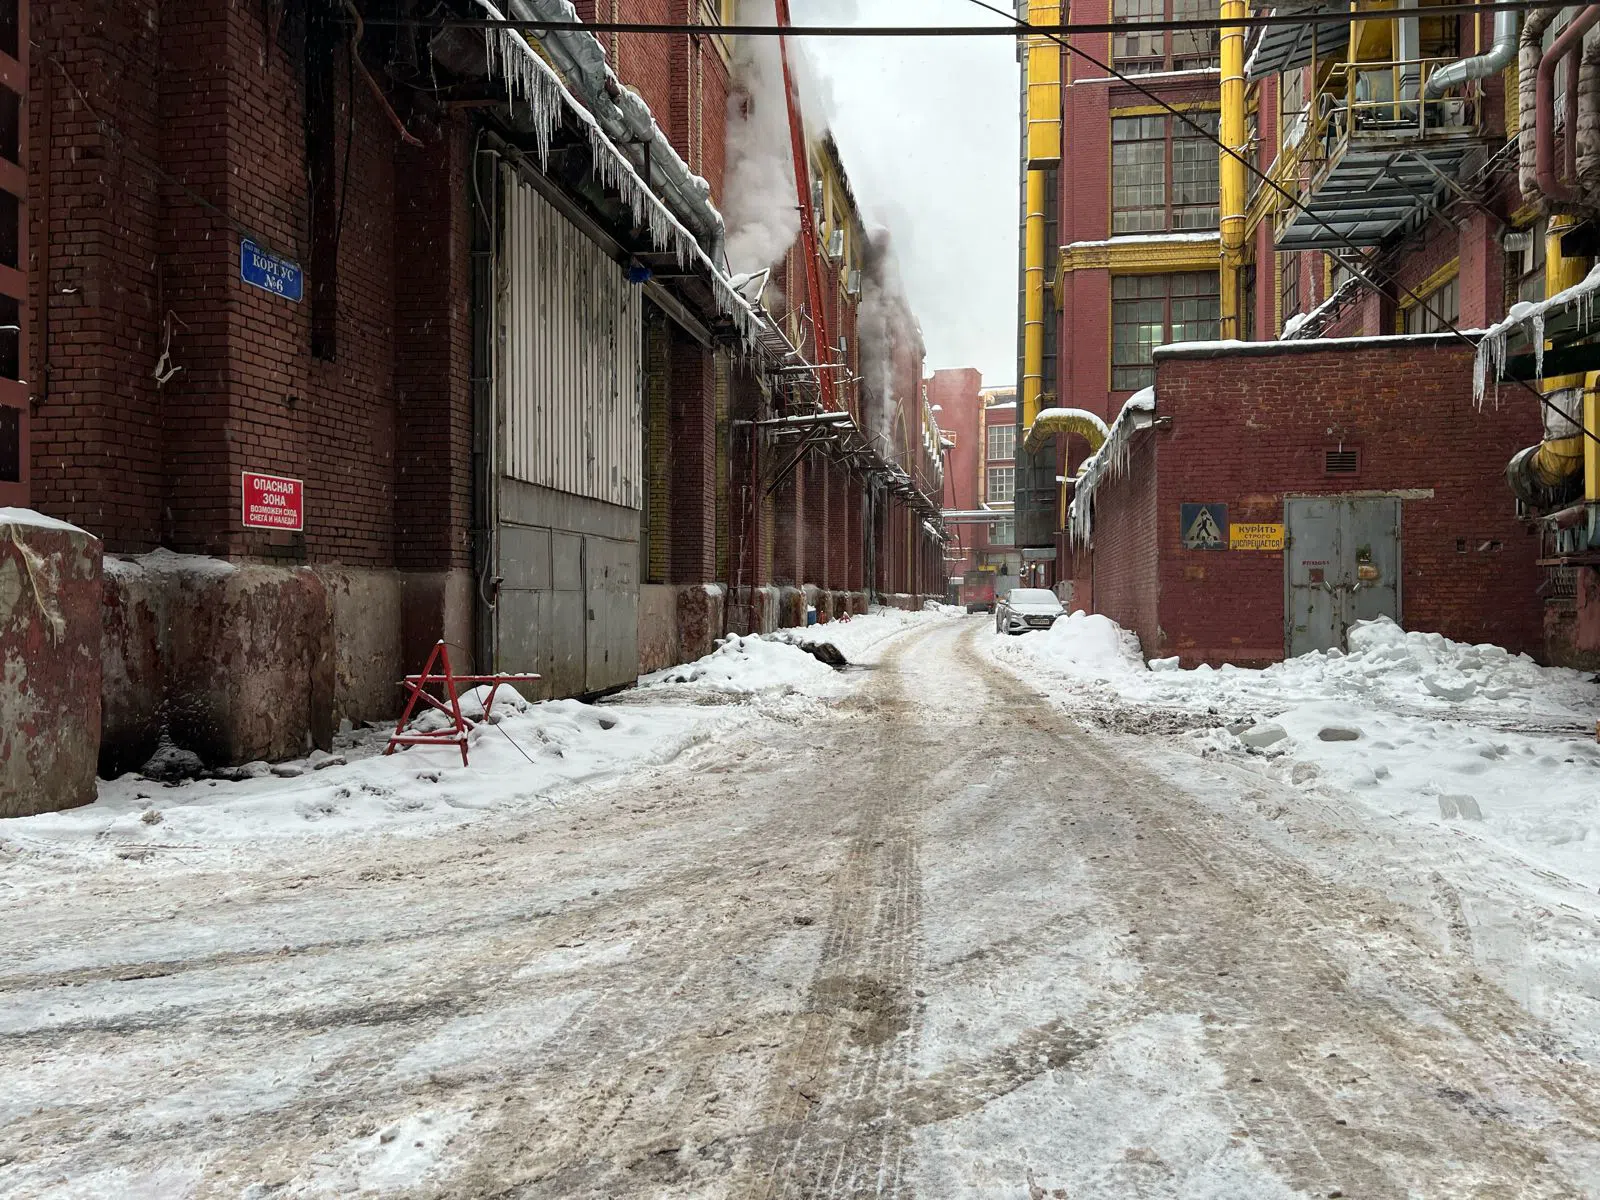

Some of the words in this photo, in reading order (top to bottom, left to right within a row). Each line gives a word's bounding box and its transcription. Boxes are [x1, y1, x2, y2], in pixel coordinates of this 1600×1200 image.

[264, 274, 284, 293] №6
[253, 478, 294, 494] ОПАСНАЯ
[262, 493, 286, 506] ЗОНА
[250, 505, 283, 516] ВОЗМОЖЕН
[283, 508, 297, 517] СХОД
[250, 514, 268, 522] СНЕГА
[1238, 525, 1277, 534] КУРИТЬ
